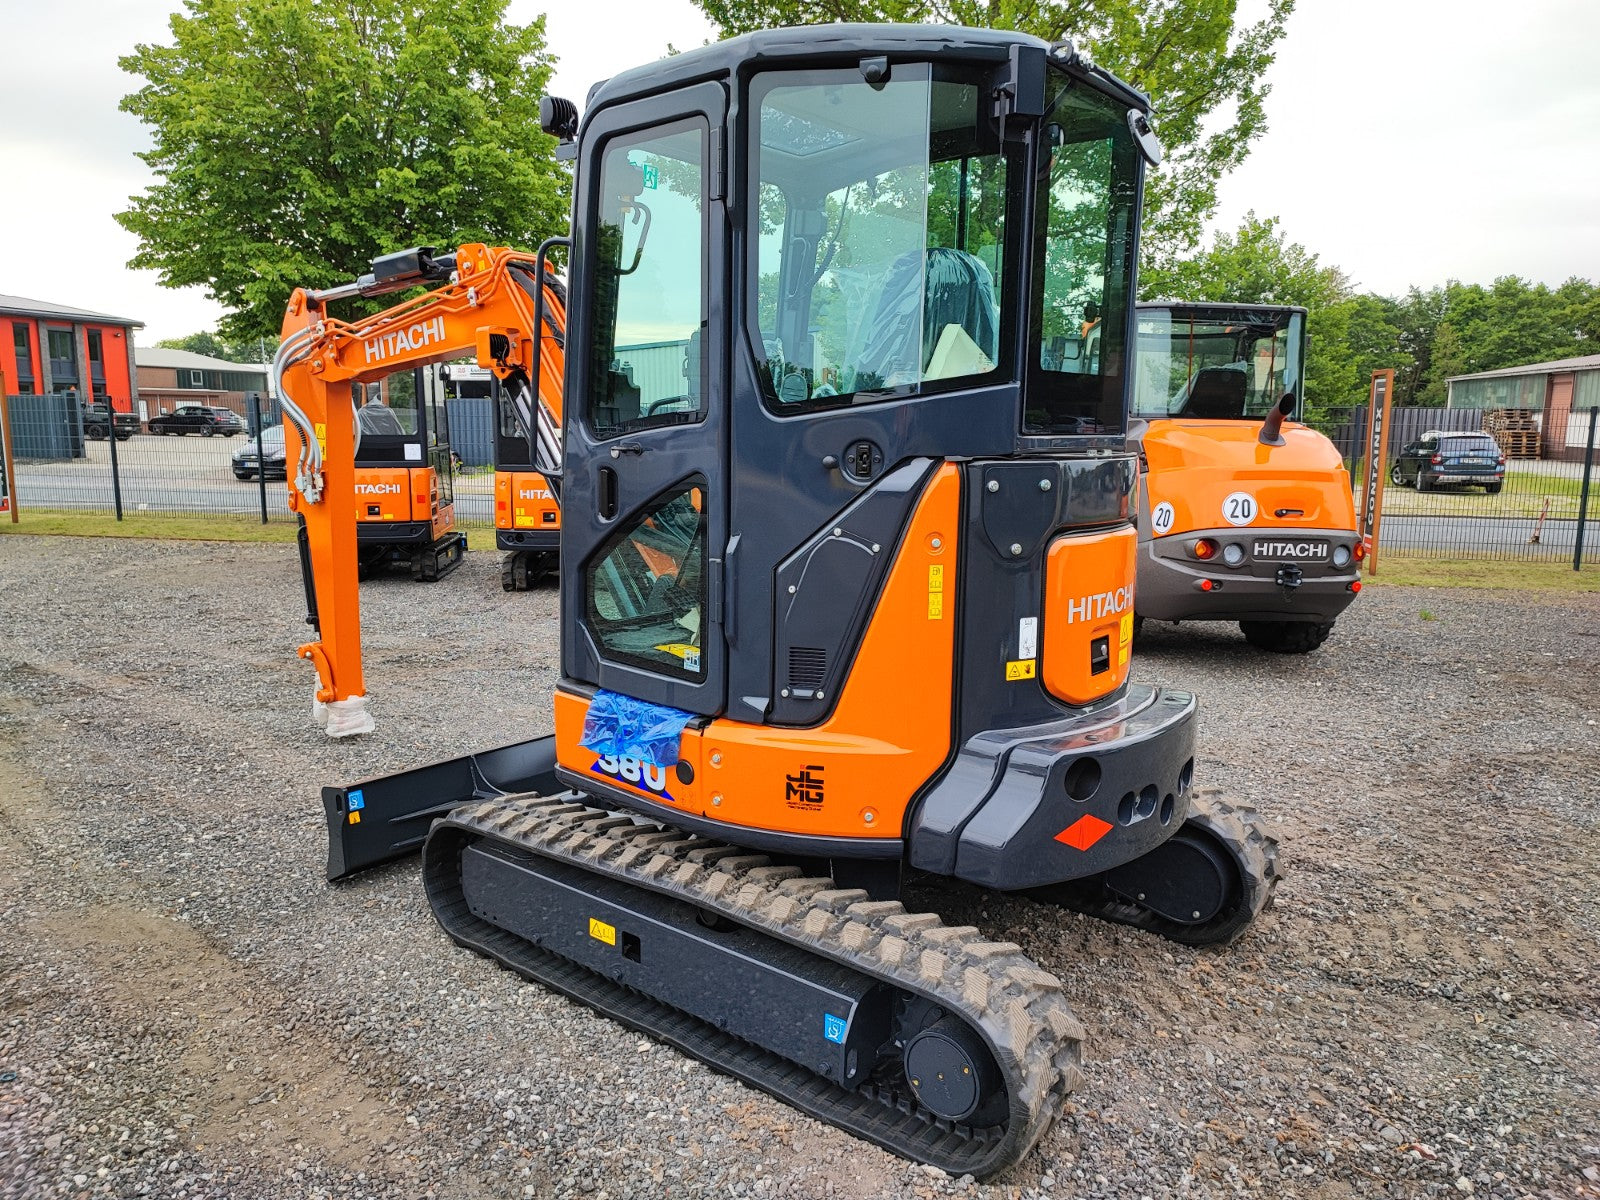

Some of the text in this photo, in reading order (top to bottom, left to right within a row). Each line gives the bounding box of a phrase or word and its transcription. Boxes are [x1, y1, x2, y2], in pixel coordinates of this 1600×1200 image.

[364, 315, 446, 364] HITACHI
[1367, 407, 1383, 526] CONTAINEX
[354, 483, 401, 494] ITACHI
[519, 489, 555, 500] HITA
[1155, 507, 1171, 528] 20
[1230, 498, 1251, 519] 20
[1253, 542, 1328, 557] HITACHI
